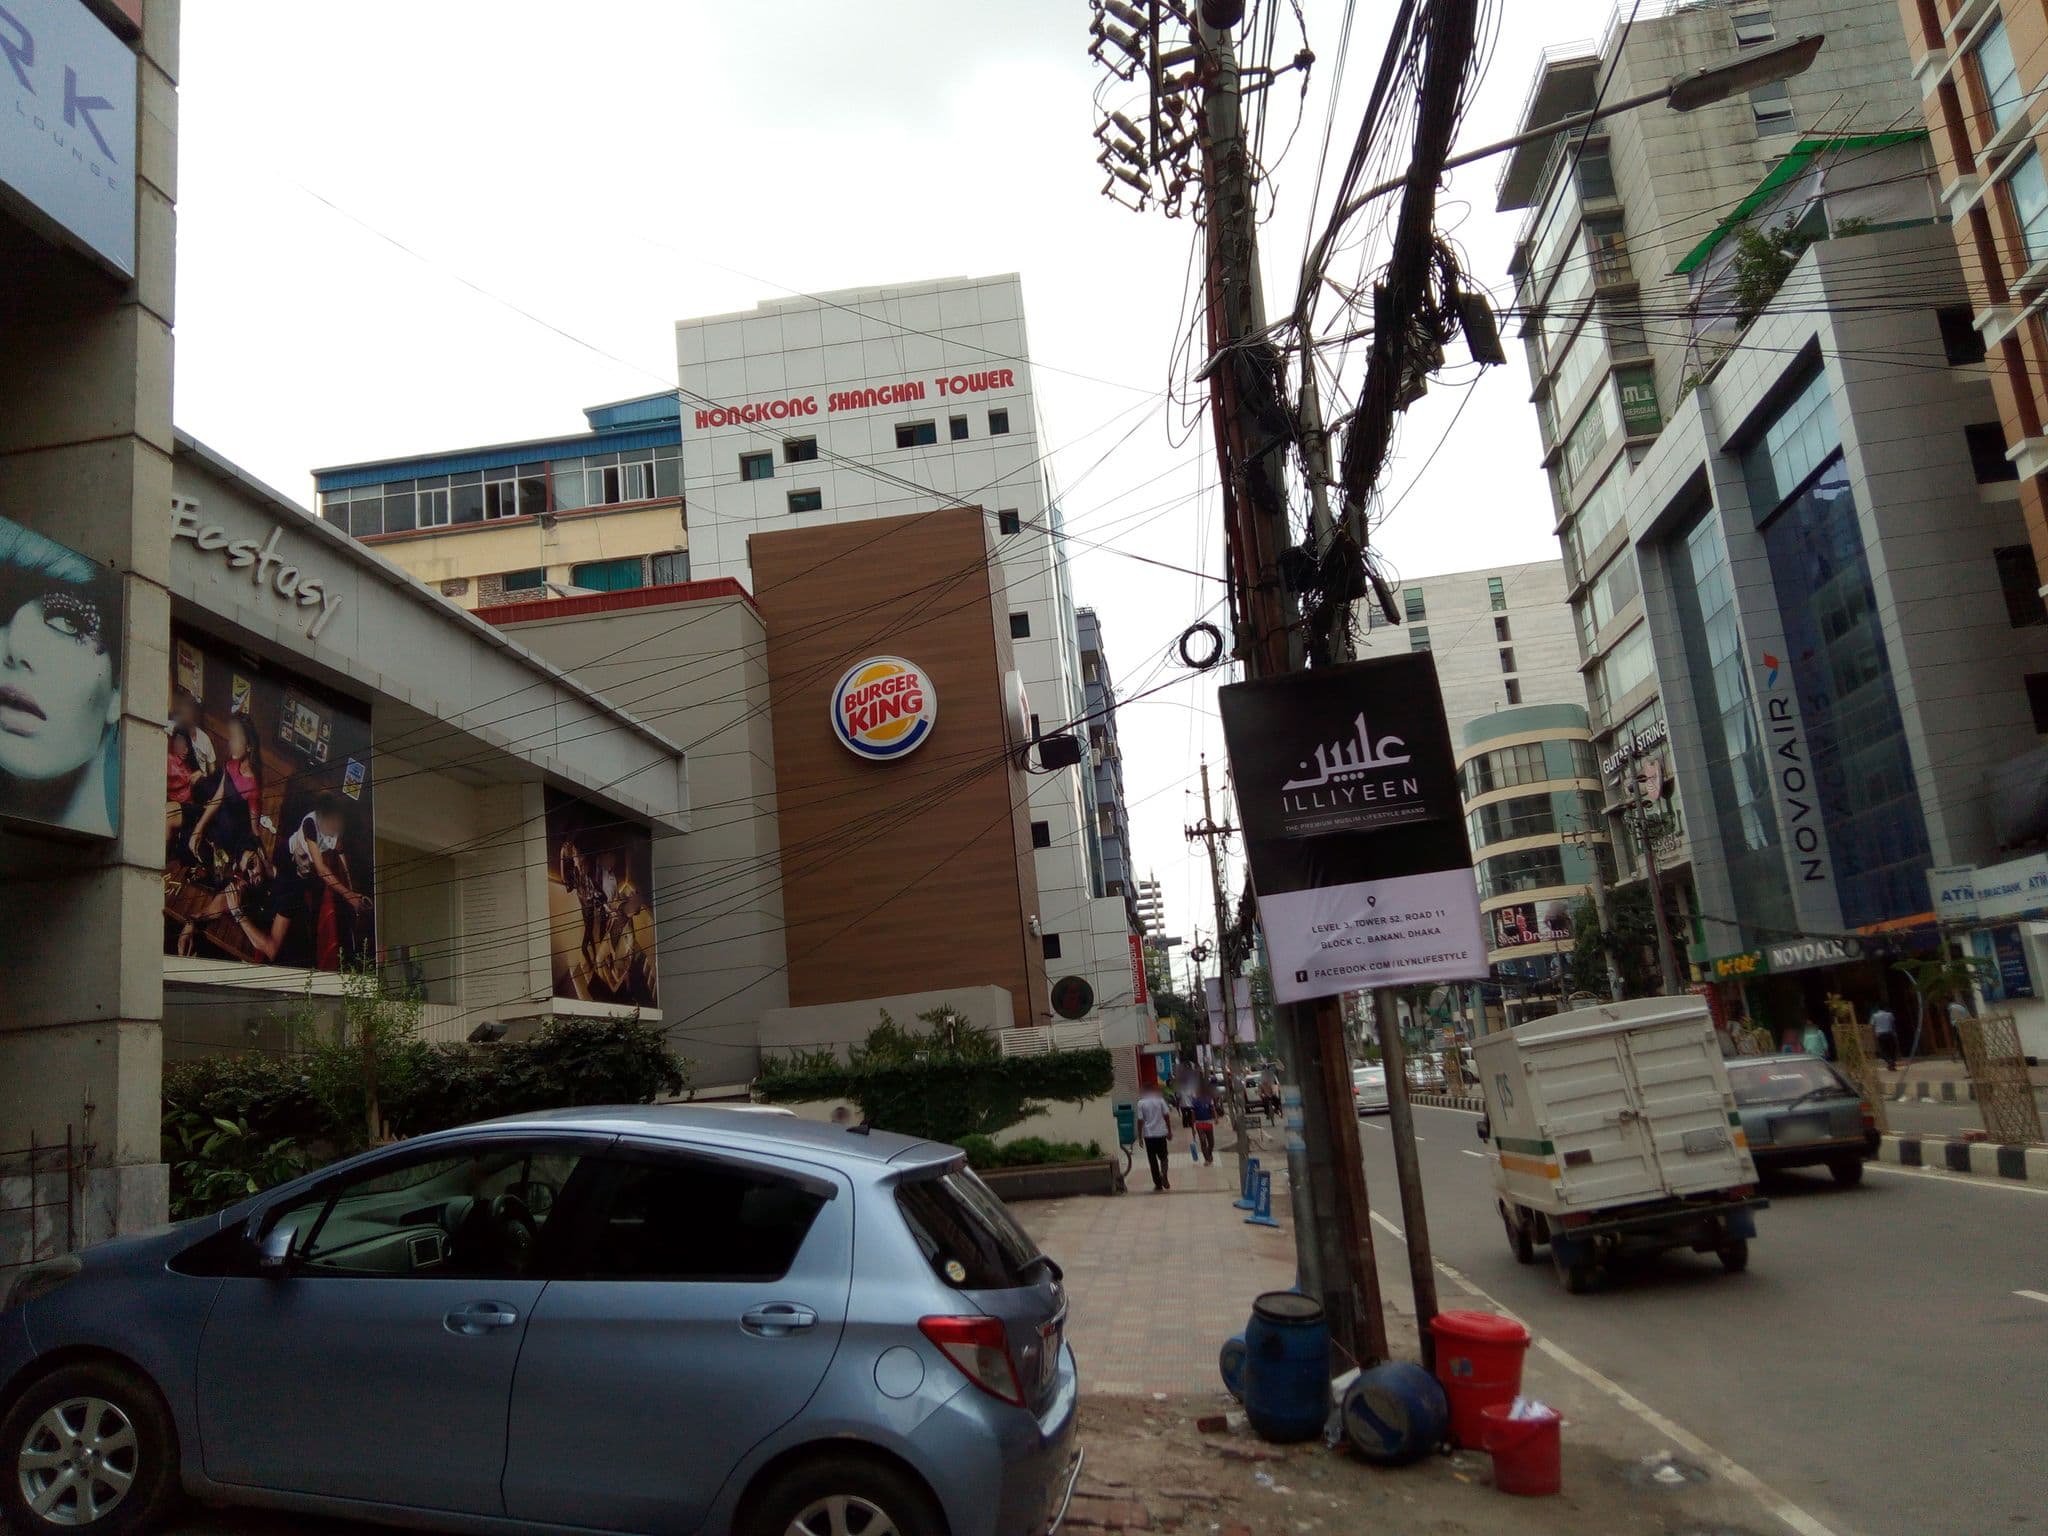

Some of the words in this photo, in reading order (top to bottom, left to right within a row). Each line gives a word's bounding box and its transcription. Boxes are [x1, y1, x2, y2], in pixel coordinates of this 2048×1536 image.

[15, 99, 119, 191] LOUNGE
[695, 396, 818, 430] HONGKONG
[827, 381, 925, 413] SHANGHAI
[935, 368, 1015, 397] TOWER
[845, 673, 919, 714] BURGER
[849, 689, 924, 738] KING
[1636, 720, 1666, 751] STRING
[1282, 778, 1418, 813] ILLIYEEN
[1768, 697, 1825, 881] NOVOAIR
[1300, 819, 1332, 830] PREMIUM
[1362, 811, 1399, 822] LIFESTYLE
[1400, 807, 1425, 817] BRAND
[1312, 923, 1341, 934] LEVEL
[1355, 916, 1387, 927] TOWER
[1405, 911, 1433, 921] ROAD
[1436, 909, 1446, 918] 11
[1321, 939, 1353, 950] BLOCK
[1408, 927, 1441, 939] DHAKA
